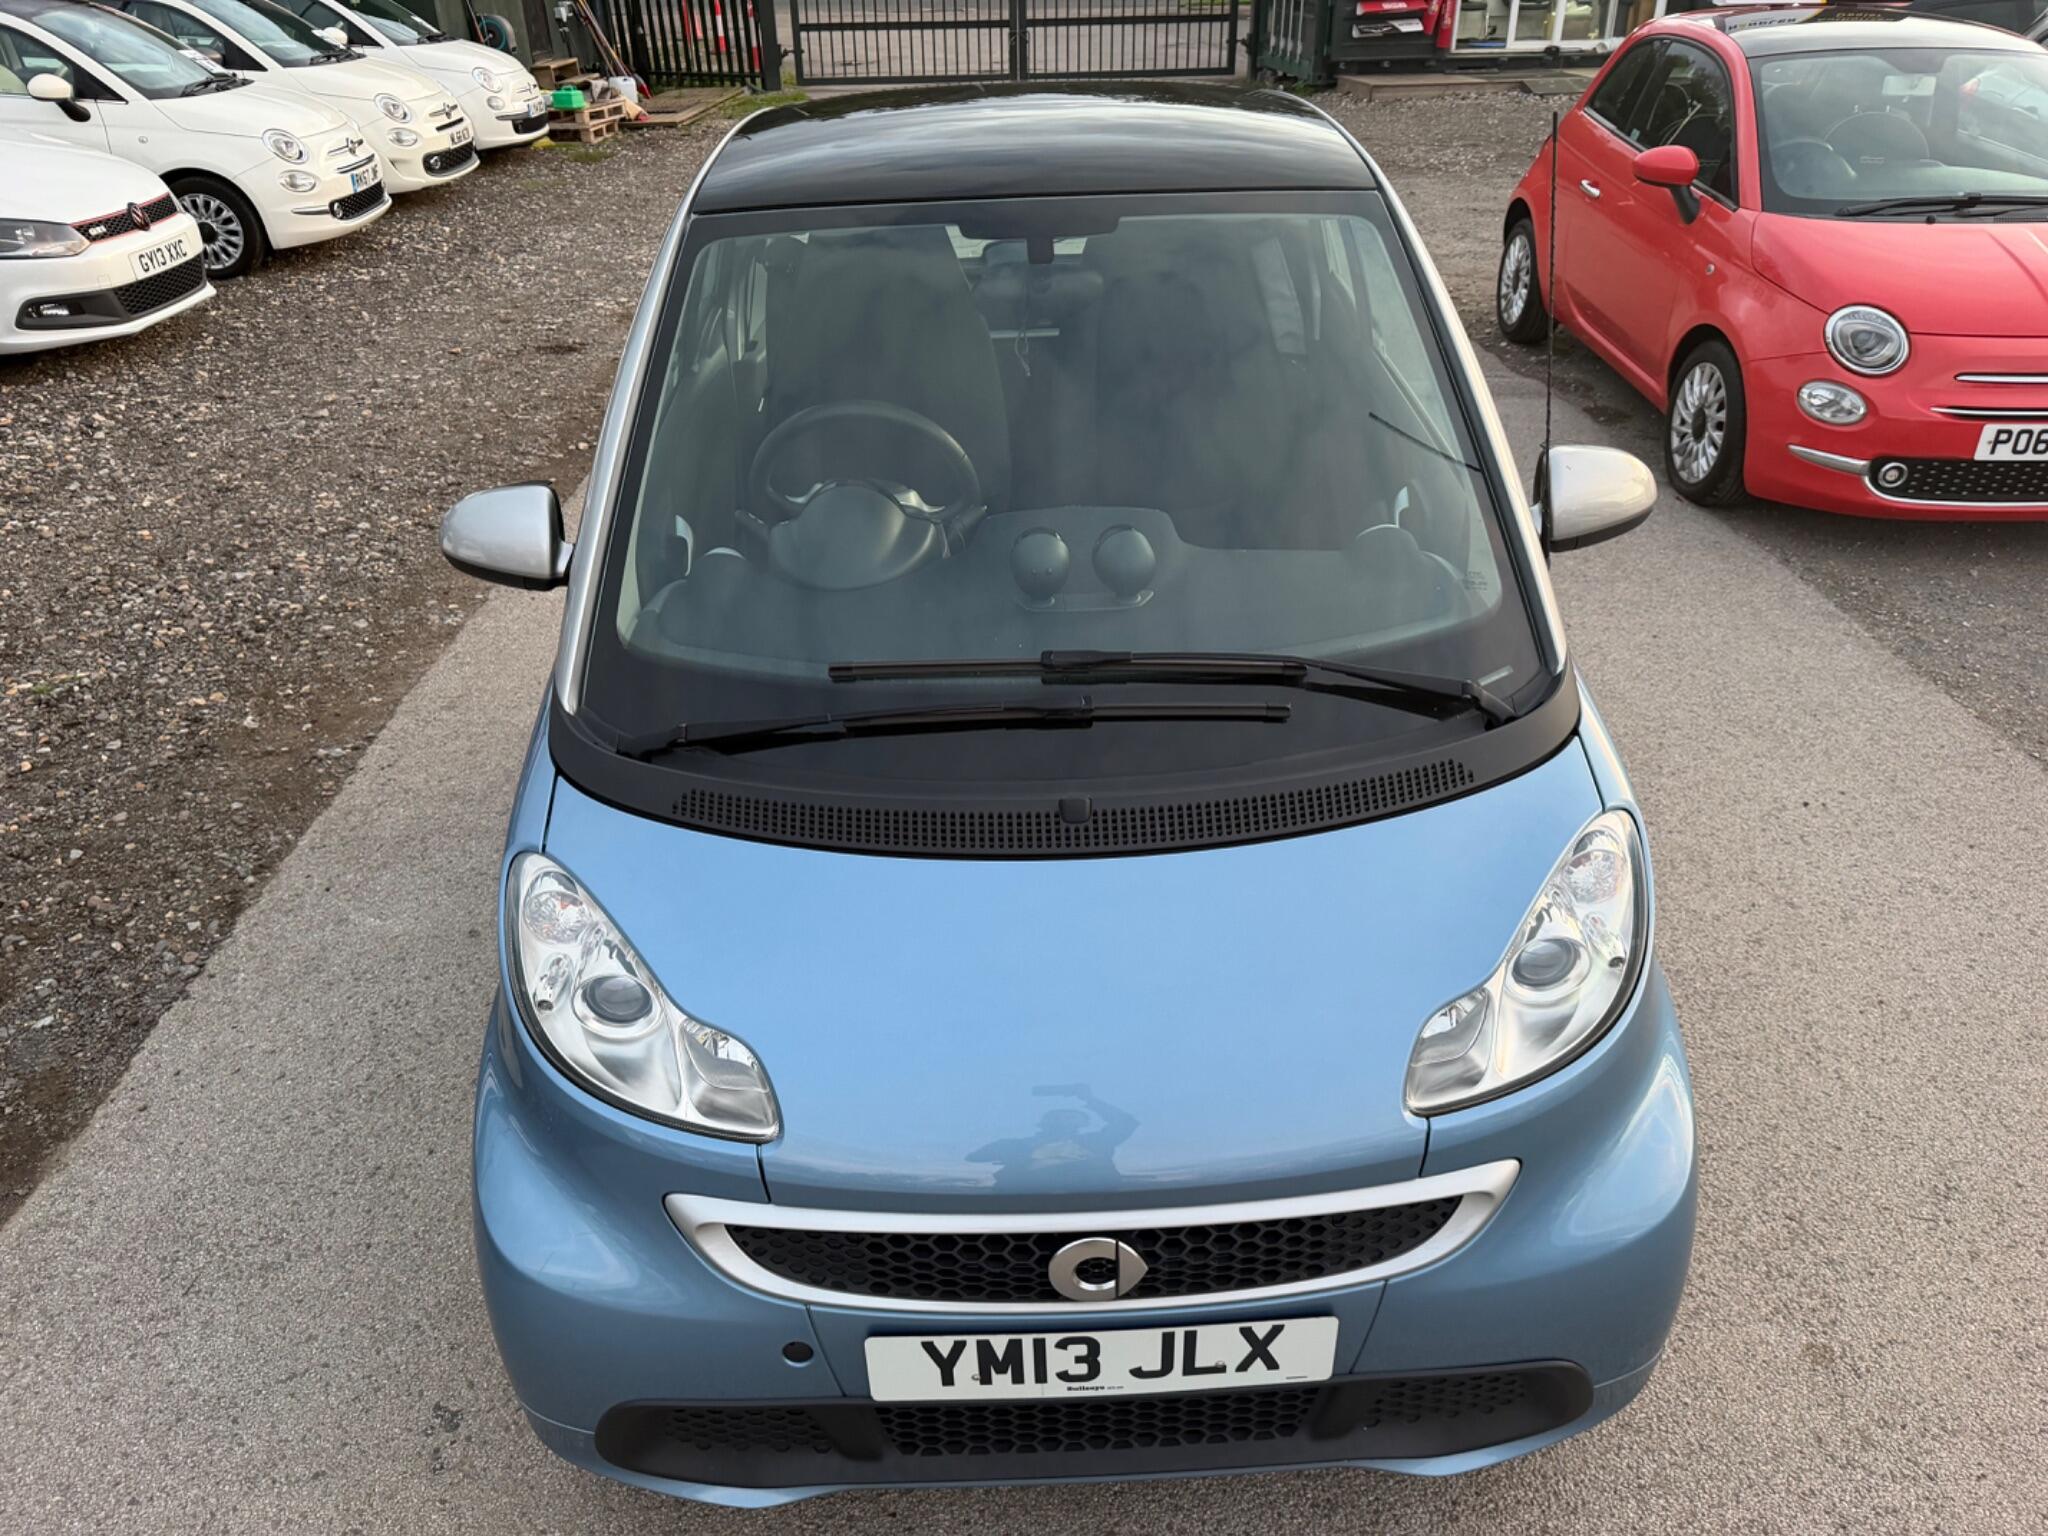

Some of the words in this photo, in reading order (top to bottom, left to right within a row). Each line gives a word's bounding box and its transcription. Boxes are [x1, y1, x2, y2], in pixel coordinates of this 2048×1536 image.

[138, 247, 168, 273] GY13
[167, 239, 188, 263] XXC
[921, 1335, 1101, 1387] YM13
[1129, 1323, 1285, 1379] JLX
